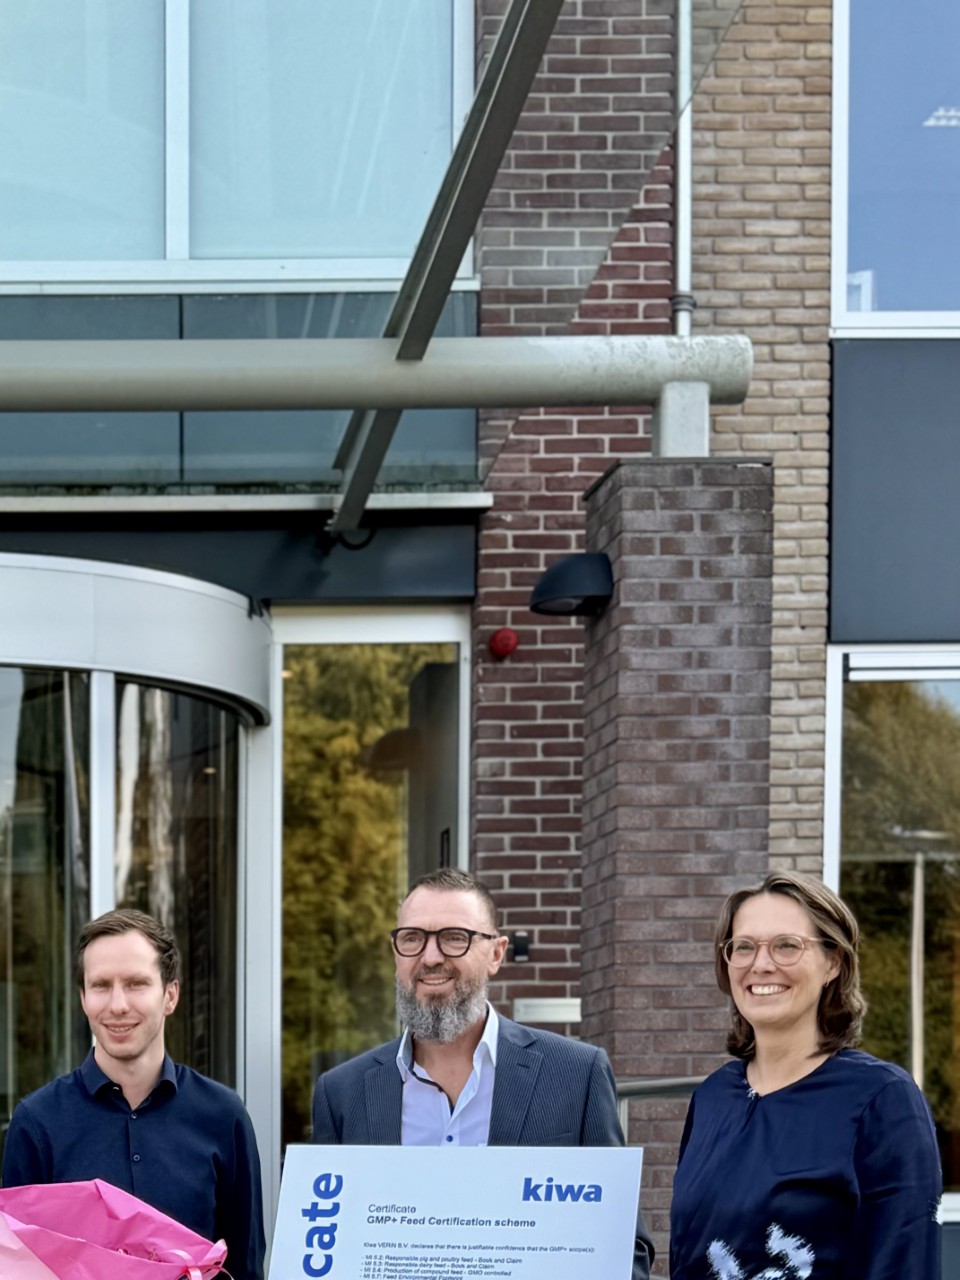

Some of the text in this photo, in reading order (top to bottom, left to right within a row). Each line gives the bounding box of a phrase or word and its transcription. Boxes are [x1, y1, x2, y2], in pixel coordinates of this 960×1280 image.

[522, 1177, 604, 1204] kiwa
[368, 1203, 416, 1213] Certificate
[366, 1215, 536, 1227] GMP+ Feed Certification scheme
